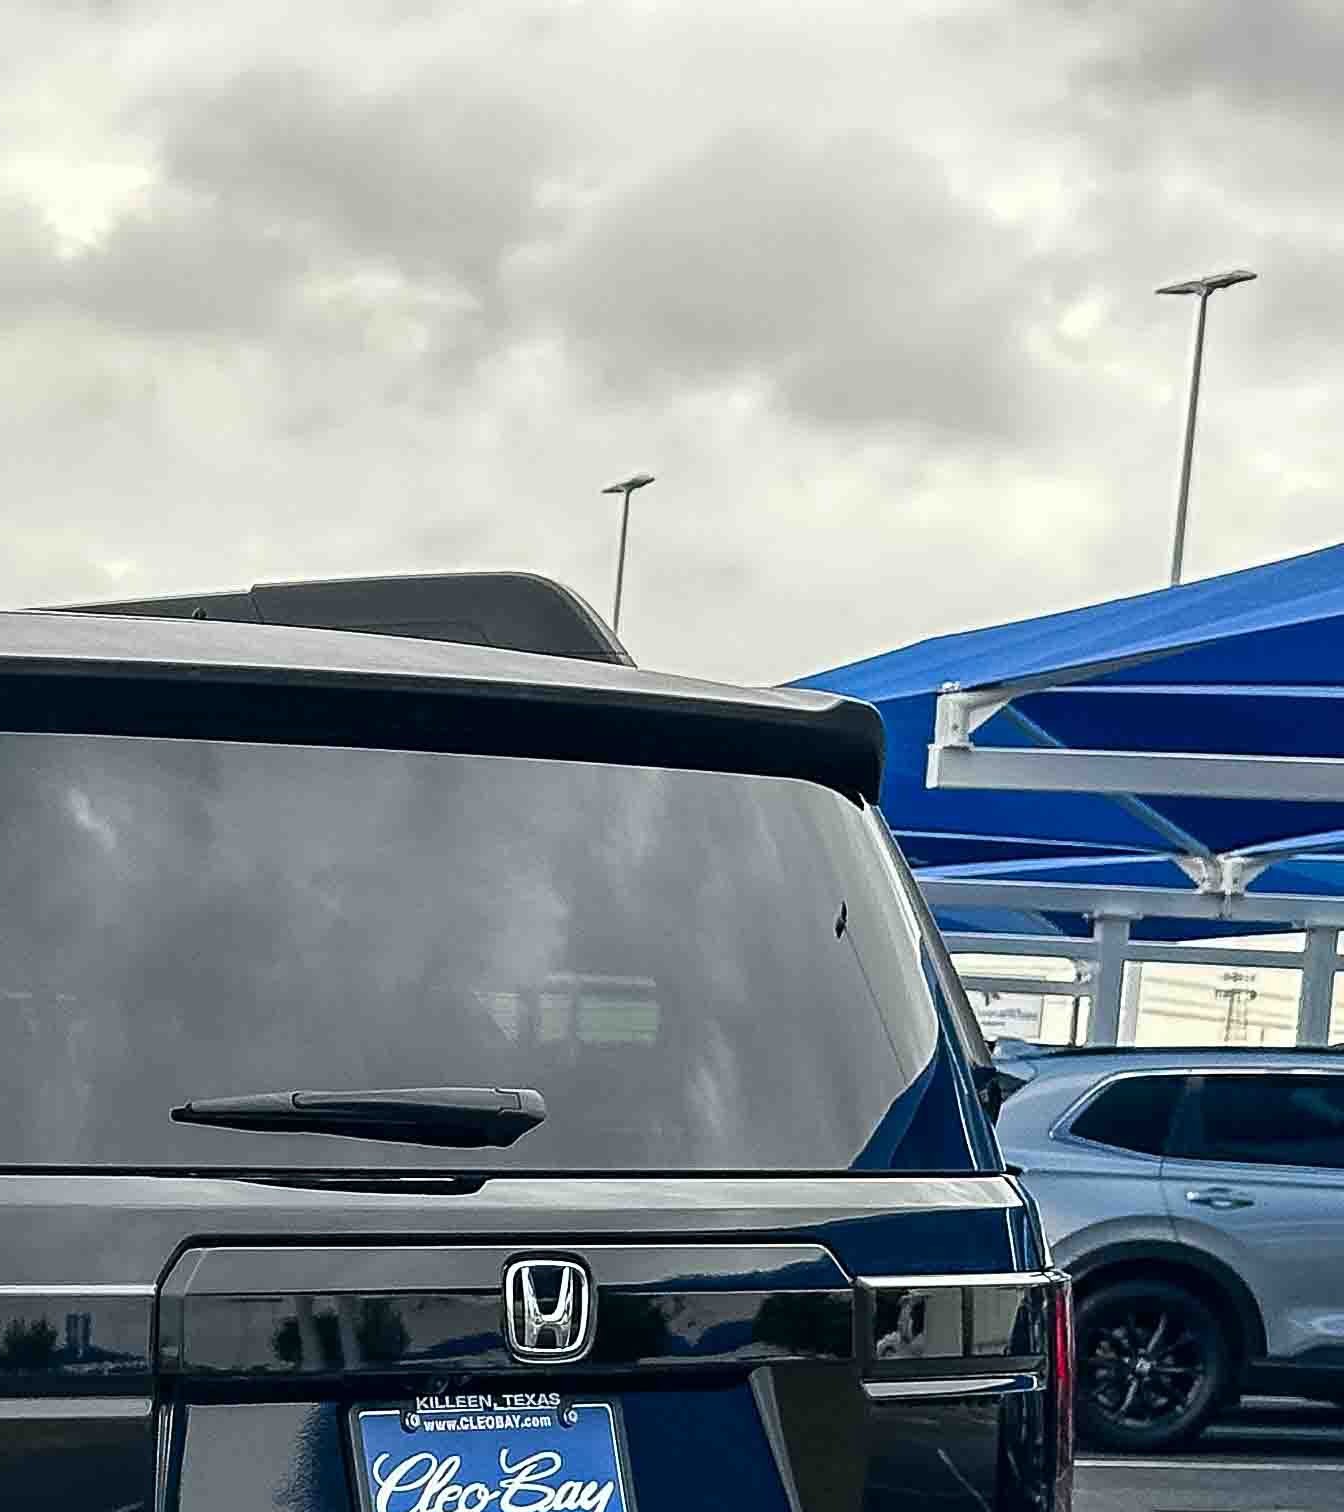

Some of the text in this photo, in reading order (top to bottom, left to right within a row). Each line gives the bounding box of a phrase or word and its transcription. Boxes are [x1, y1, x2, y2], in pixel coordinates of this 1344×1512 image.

[415, 1392, 561, 1411] KILLEEN, TEXAS
[423, 1414, 552, 1432] www.CLEOBAY.com
